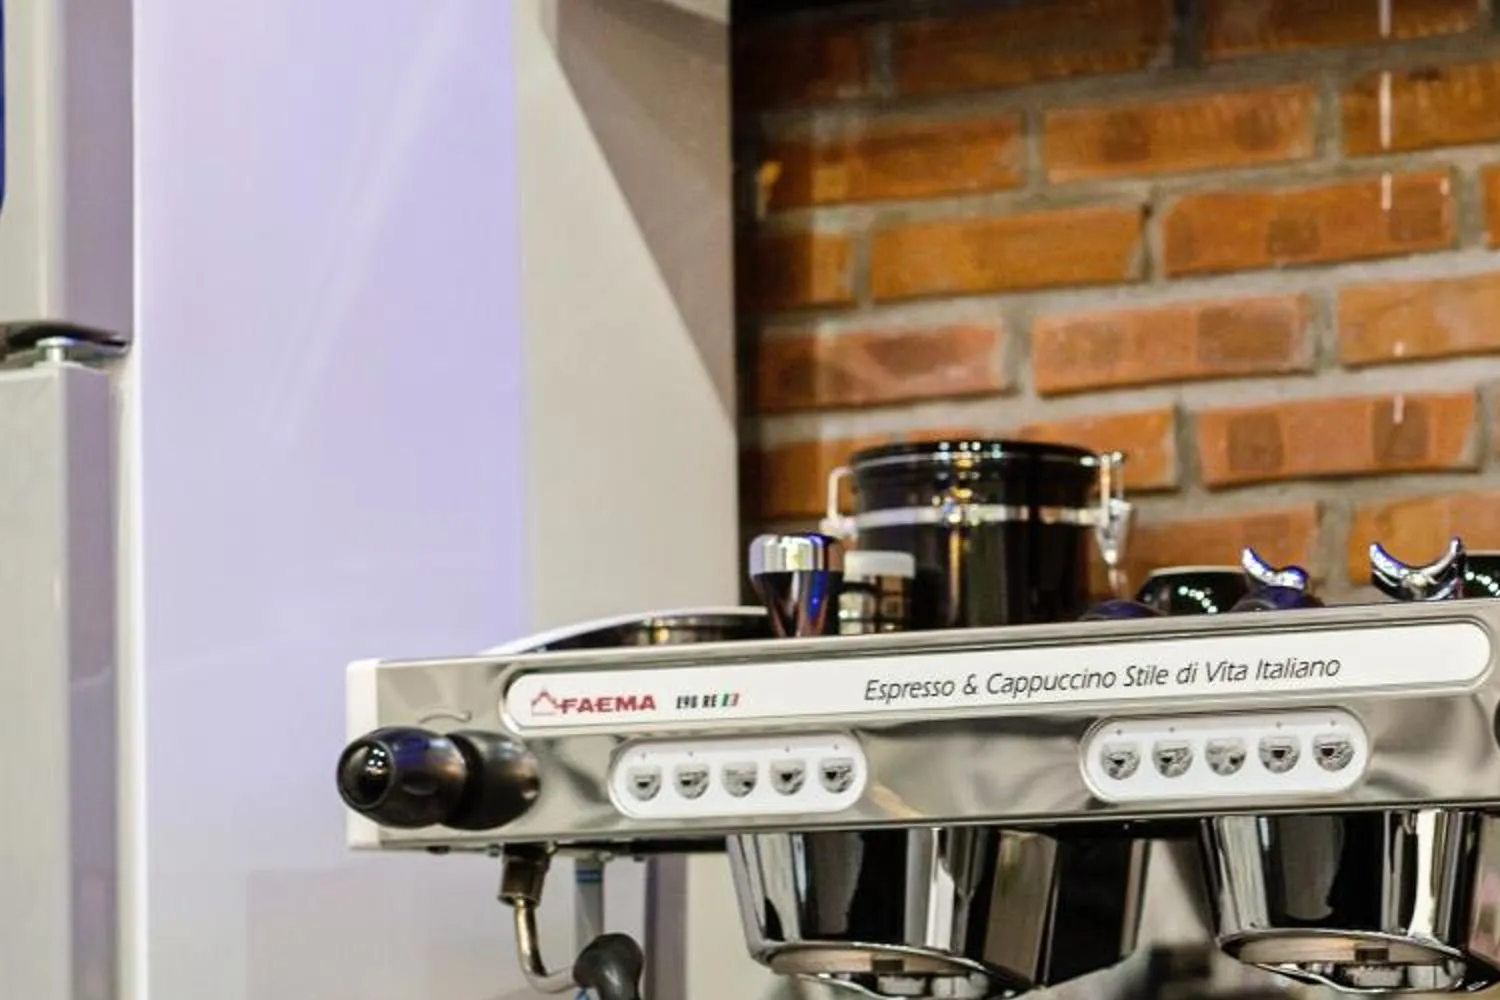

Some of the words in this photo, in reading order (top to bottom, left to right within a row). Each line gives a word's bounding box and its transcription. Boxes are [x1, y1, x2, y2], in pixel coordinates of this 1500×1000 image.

[864, 678, 956, 704] Espresso
[962, 673, 979, 695] &
[986, 667, 1117, 699] Cappuccino
[1123, 663, 1170, 688] Stile
[1175, 661, 1199, 685] di
[1204, 659, 1248, 683] Vita
[1255, 657, 1341, 681] Italiano
[557, 694, 657, 715] FAEMA
